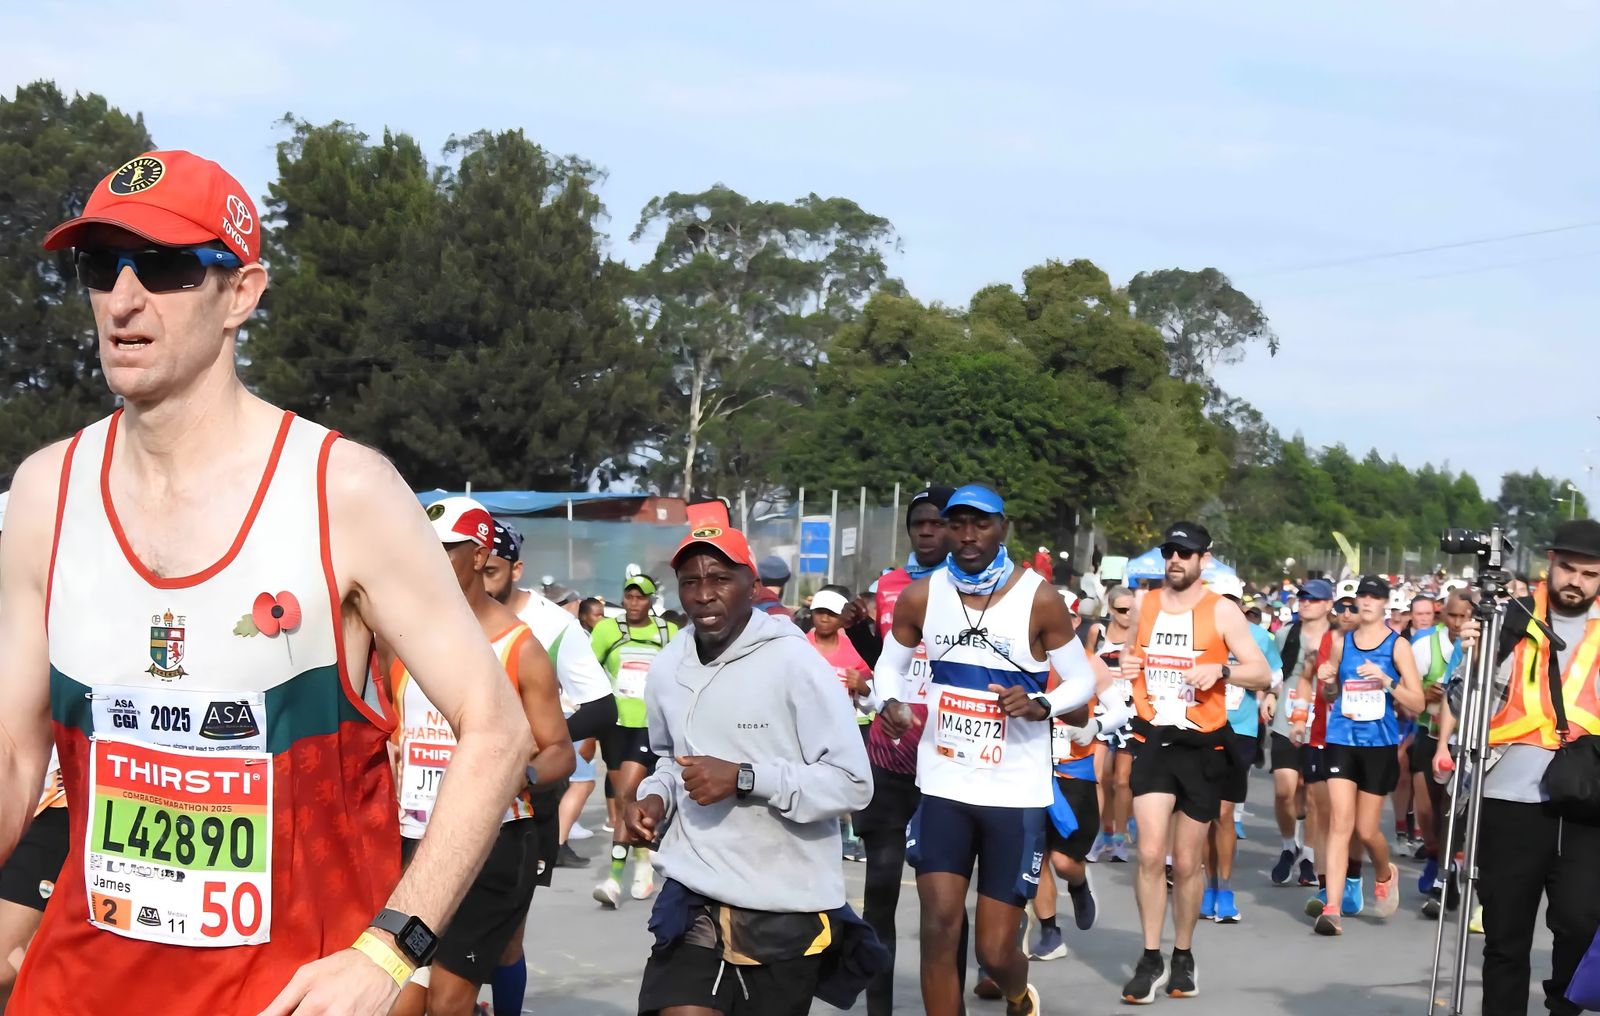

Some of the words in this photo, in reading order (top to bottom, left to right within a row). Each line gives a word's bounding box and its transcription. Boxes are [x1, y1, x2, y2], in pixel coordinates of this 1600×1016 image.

[223, 217, 249, 257] TOYOTA
[1156, 632, 1188, 647] TOTI
[114, 698, 135, 709] ASA
[113, 713, 139, 731] CGA
[150, 704, 191, 733] 2025
[206, 706, 252, 724] ASA
[942, 713, 1002, 740] M48272
[979, 744, 1003, 765] 40
[123, 790, 163, 806] COMRADES
[163, 798, 209, 812] MARATHON
[210, 805, 233, 813] 2025
[102, 799, 254, 869] L42890
[93, 874, 131, 893] James
[102, 898, 118, 925] 2
[139, 906, 160, 920] ASA
[199, 881, 263, 938] 50
[168, 918, 185, 934] 11
